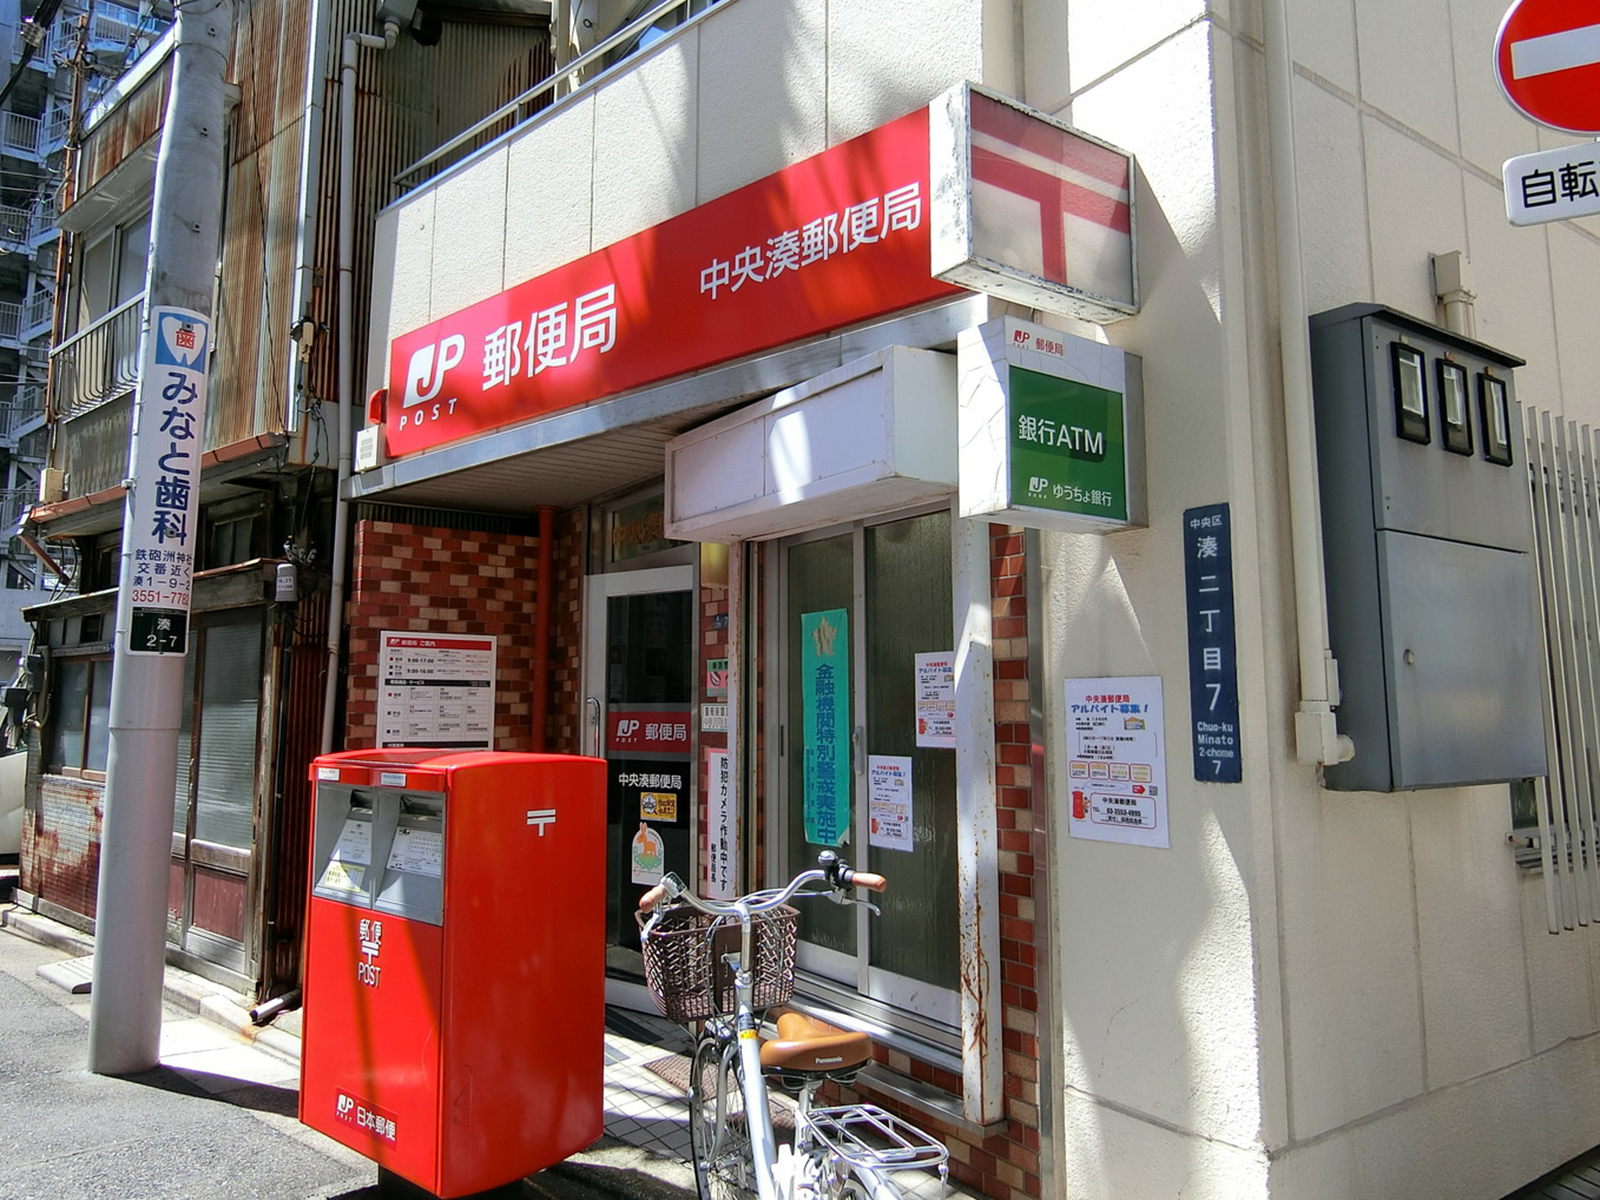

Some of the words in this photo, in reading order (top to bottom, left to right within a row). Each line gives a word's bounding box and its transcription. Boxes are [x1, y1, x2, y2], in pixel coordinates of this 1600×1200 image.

[1520, 160, 1600, 208] 自転
[699, 181, 922, 300] 中央湊郵便局
[176, 329, 196, 349] 歯
[482, 283, 617, 391] 郵便局
[1035, 337, 1064, 356] 郵便局
[399, 398, 457, 431] POST
[1018, 414, 1103, 455] 銀行ATM
[151, 371, 198, 546] みなと歯科
[1053, 483, 1112, 507] ゆうちょ銀行
[1190, 514, 1223, 529] 中央区
[138, 562, 190, 578] 交番近く
[157, 618, 171, 631] 湊
[146, 634, 177, 647] 2-7
[645, 722, 687, 741] 郵便局
[1197, 721, 1233, 732] Chuo-ku
[1197, 733, 1234, 745] Minato
[815, 662, 837, 844] 金融機関特別警戒実施中
[1199, 746, 1234, 758] 2-chome
[1212, 759, 1222, 775] 7
[618, 771, 682, 790] 中央湊郵便局
[719, 756, 729, 892] 防犯カメラ作動中です
[359, 918, 382, 946] 郵便
[358, 961, 381, 988] POST
[815, 1056, 843, 1064] Panasonic
[357, 1105, 396, 1141] 日本郵便
